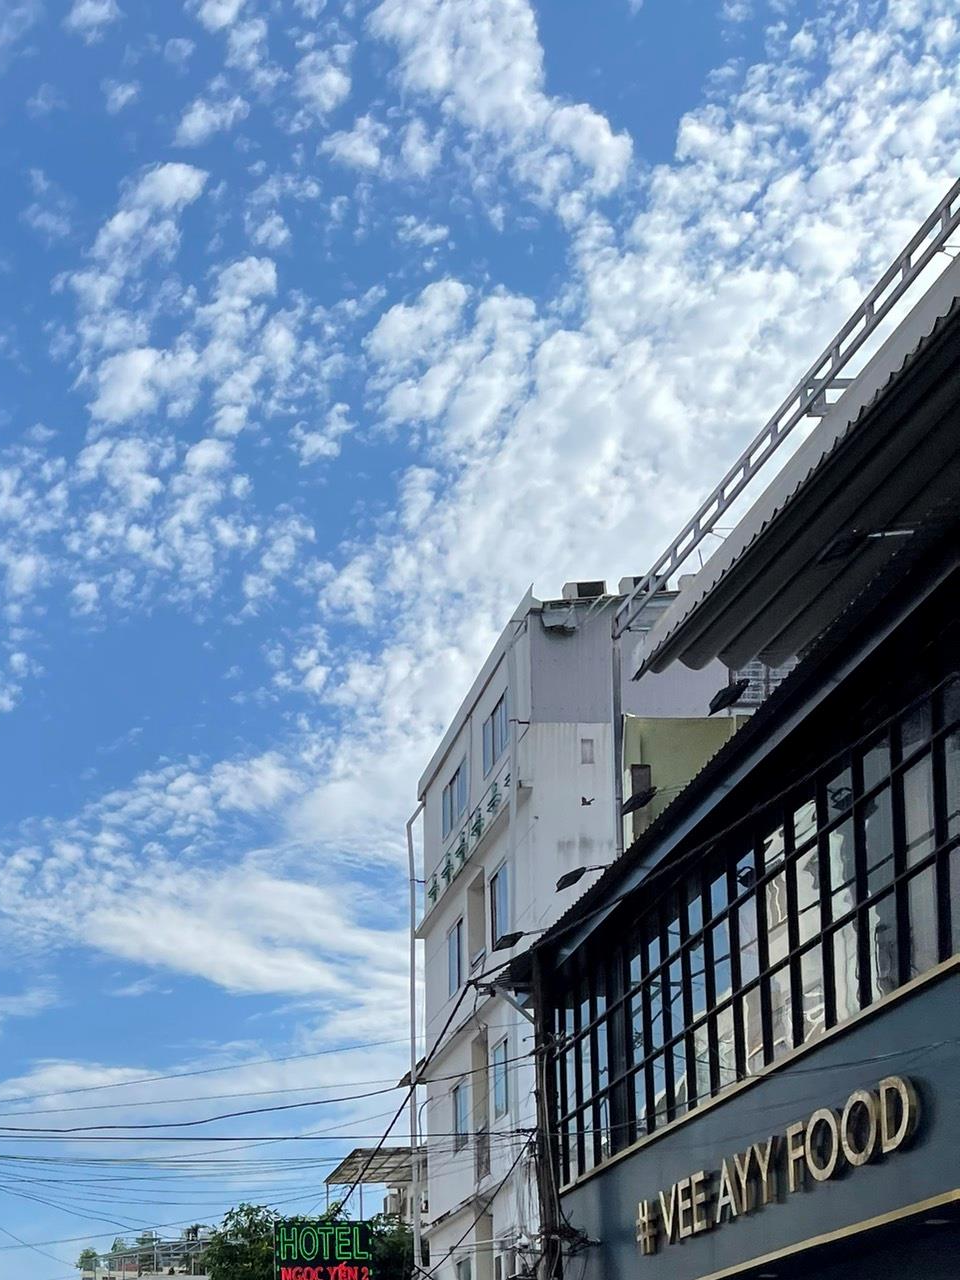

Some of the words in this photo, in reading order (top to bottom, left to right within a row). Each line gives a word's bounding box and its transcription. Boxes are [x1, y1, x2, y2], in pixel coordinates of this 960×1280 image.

[715, 1135, 782, 1224] AYY
[786, 1075, 918, 1193] FOOD
[280, 1226, 370, 1261] HOTEL
